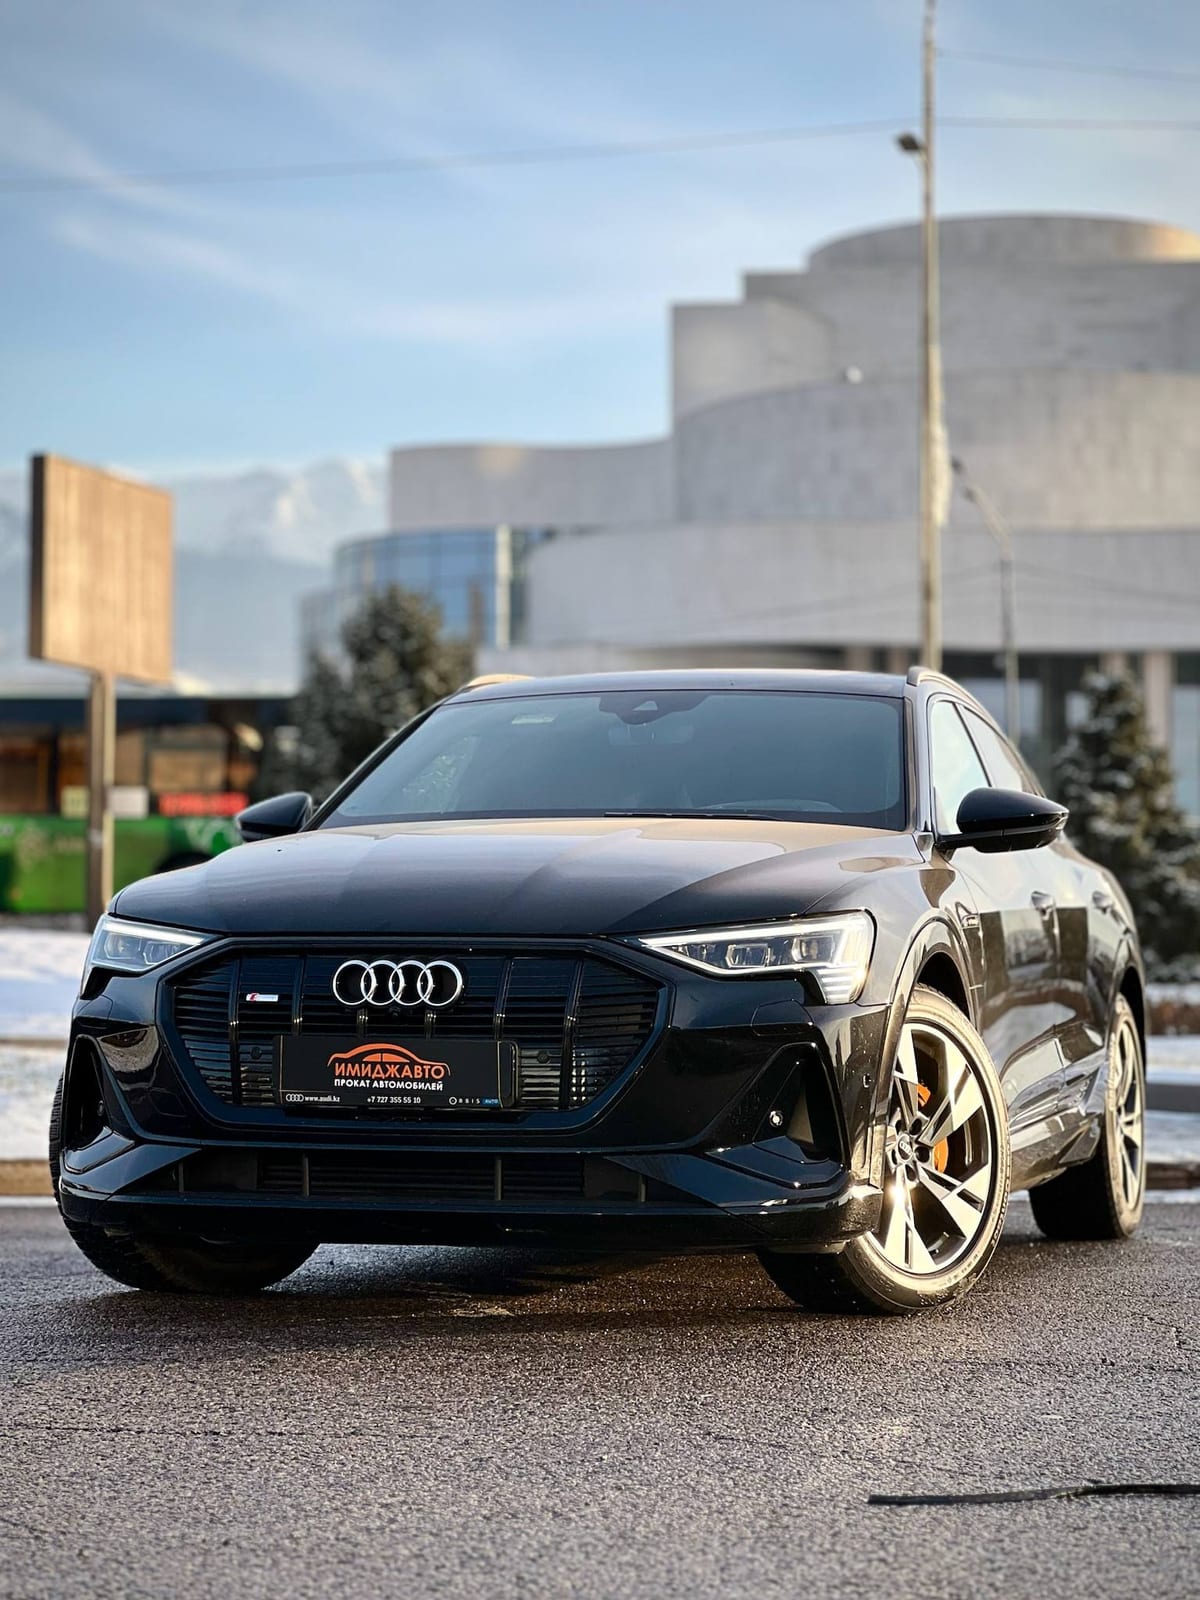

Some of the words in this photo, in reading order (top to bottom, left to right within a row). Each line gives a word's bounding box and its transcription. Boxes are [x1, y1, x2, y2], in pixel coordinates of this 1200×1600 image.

[335, 1063, 445, 1080] ИМИДЖАВТО
[334, 1079, 370, 1088] ПРОКАТ
[372, 1080, 444, 1091] АВТОМОБИЛЕЙ
[390, 1096, 402, 1104] 355
[403, 1096, 412, 1104] 55
[413, 1096, 421, 1104] 10
